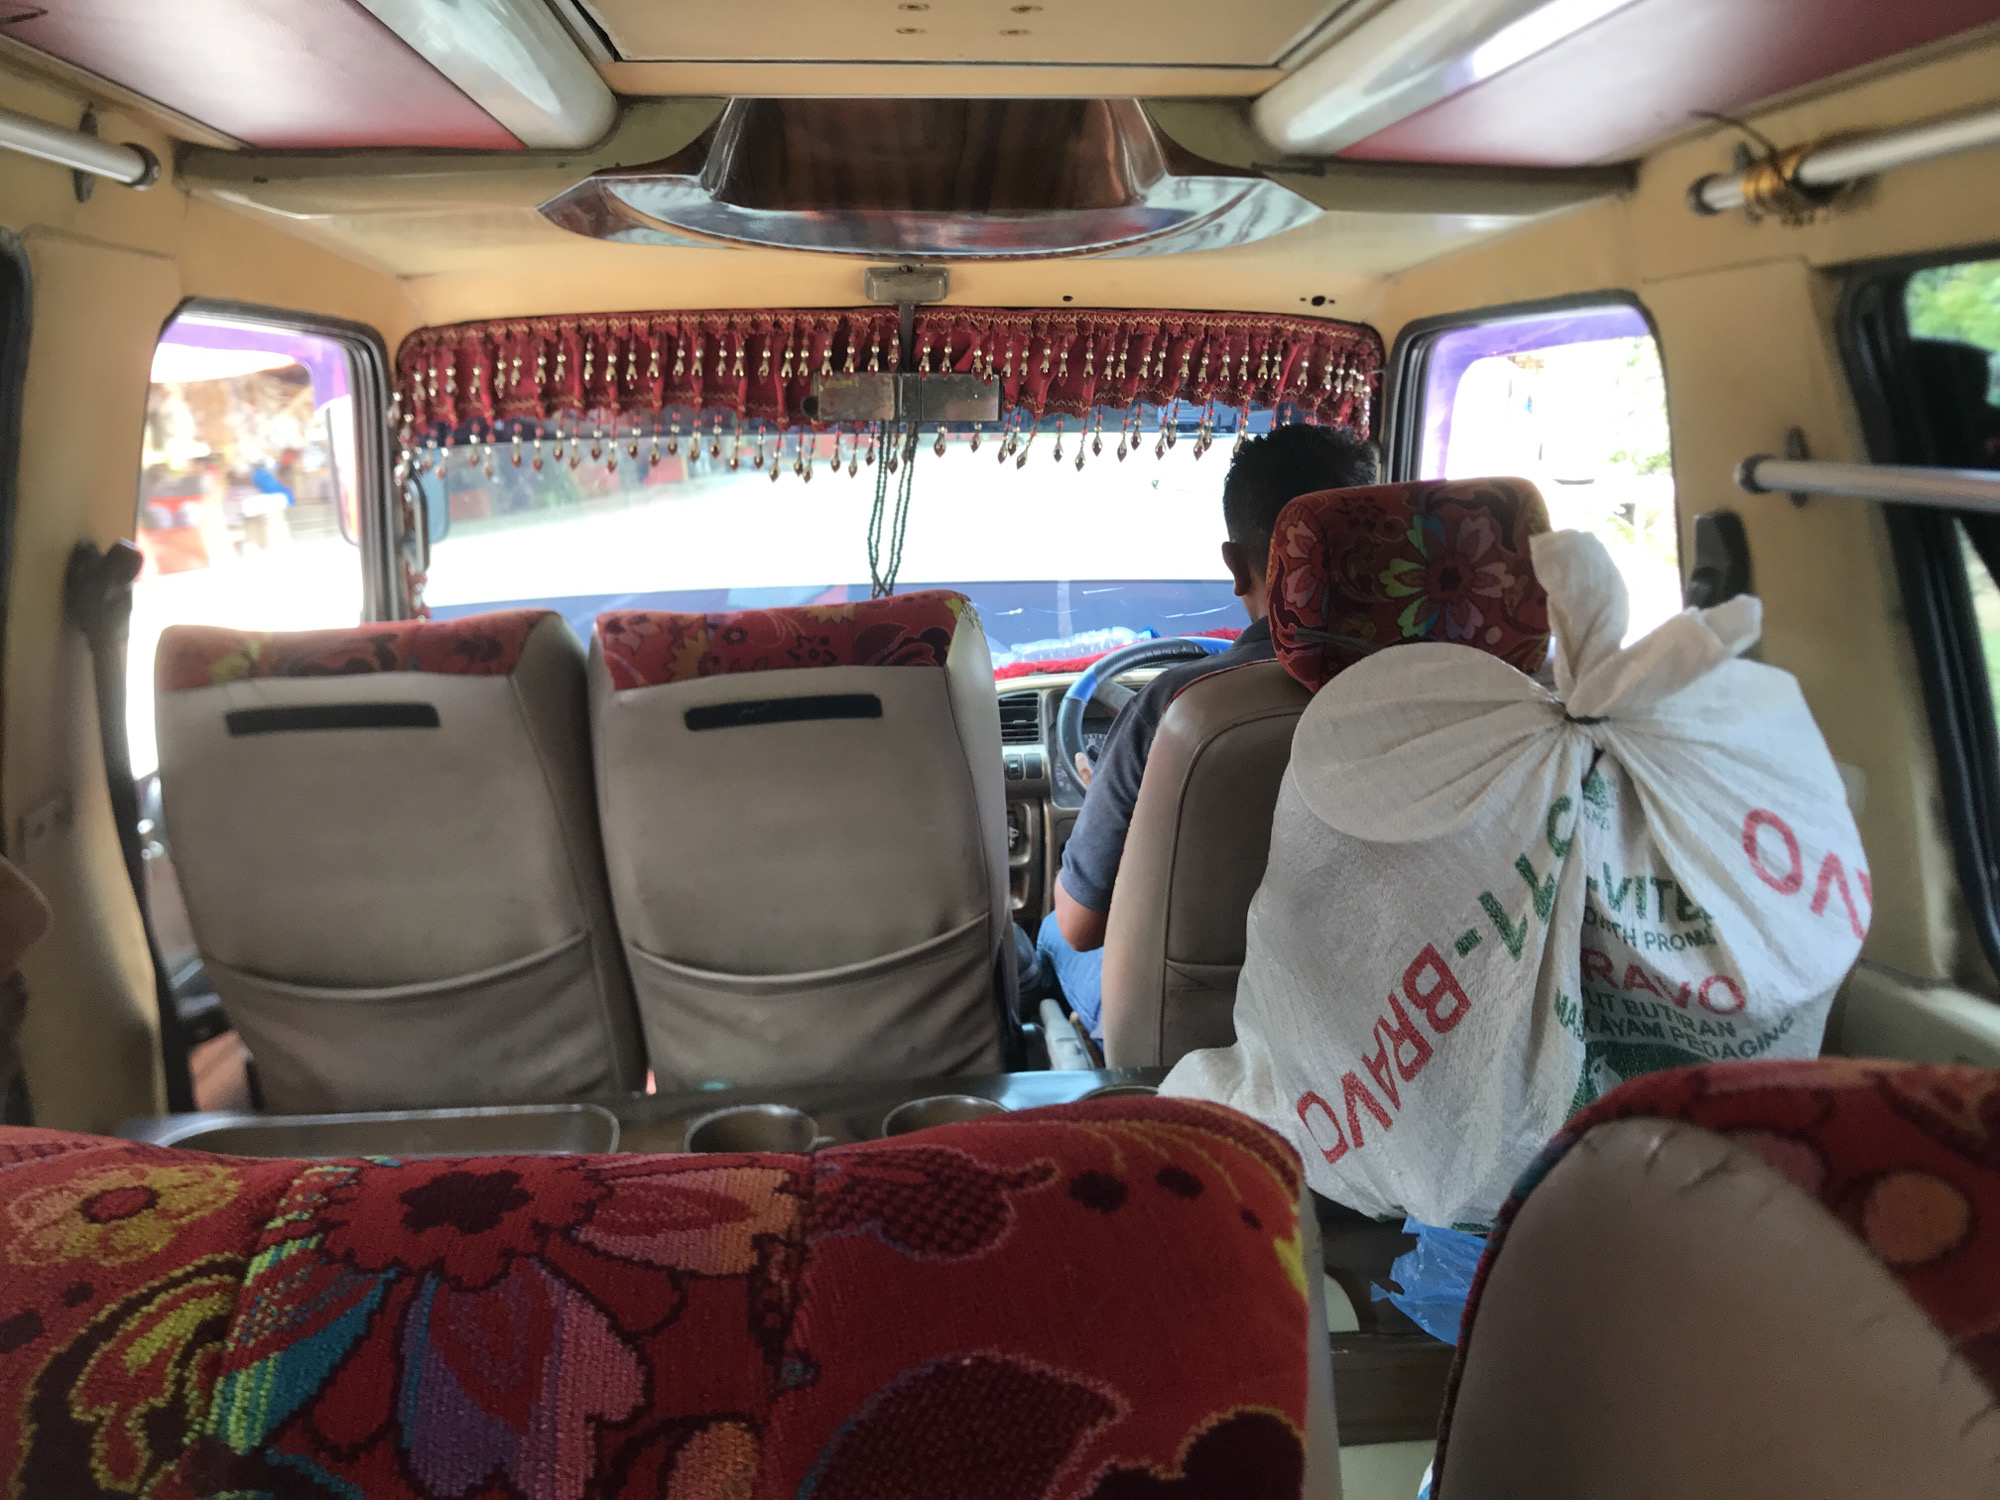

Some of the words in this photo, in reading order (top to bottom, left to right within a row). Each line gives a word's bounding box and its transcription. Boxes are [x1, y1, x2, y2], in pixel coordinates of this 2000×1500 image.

[1600, 1012, 1666, 1041] AYAM
[1671, 1013, 1795, 1061] PEDAGING
[1622, 996, 1737, 1038] BUTIRAN
